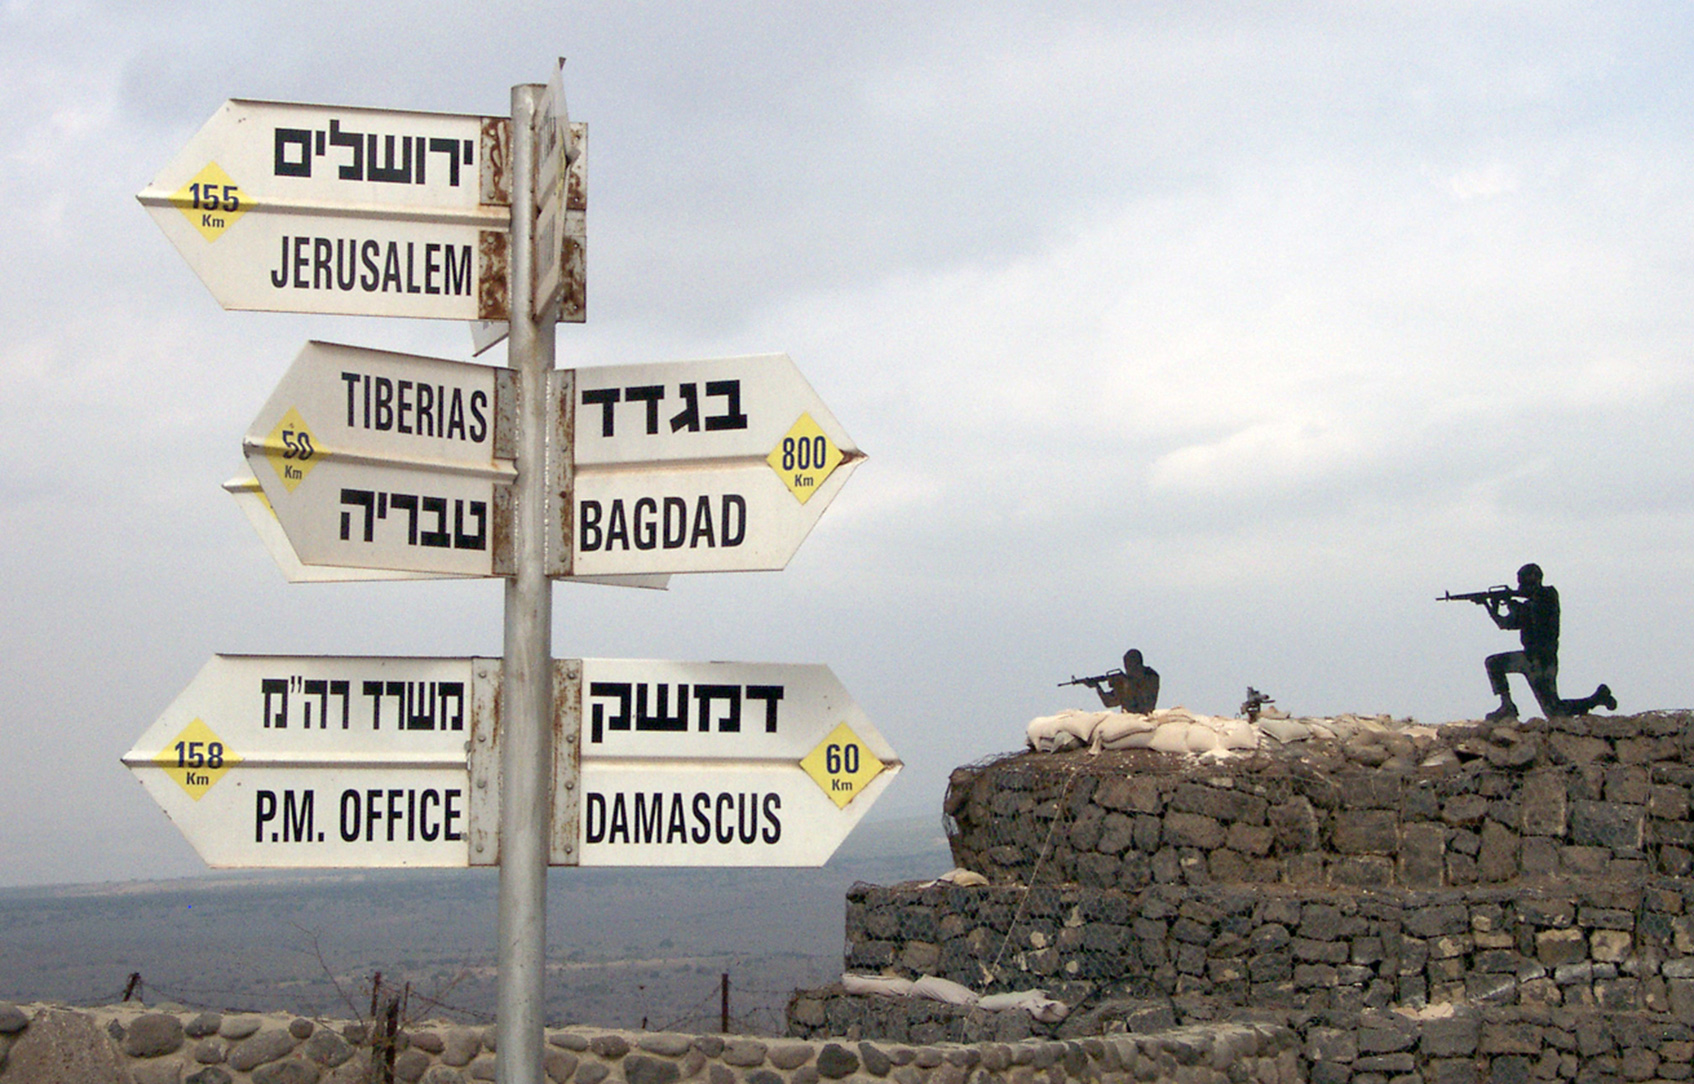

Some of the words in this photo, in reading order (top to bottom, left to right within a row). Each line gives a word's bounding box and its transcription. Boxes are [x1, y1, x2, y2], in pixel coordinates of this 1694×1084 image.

[274, 119, 474, 187] ירושלים
[188, 183, 239, 213] 155
[201, 213, 225, 228] Km
[270, 235, 473, 297] JERUSALEM
[341, 371, 488, 443] TIBERIAS
[581, 379, 748, 438] בגדד
[282, 430, 315, 461] 50
[782, 435, 827, 471] 800
[284, 465, 303, 480] Km
[794, 473, 814, 488] Km
[340, 488, 487, 551] טבריה
[580, 494, 747, 552] BAGDAD
[362, 681, 464, 731] משרד
[590, 682, 785, 744] דמשק
[174, 741, 224, 769] 158
[826, 743, 860, 775] 60
[186, 771, 209, 786] Km
[831, 778, 853, 792] Km
[255, 789, 325, 843] P.M.
[339, 788, 463, 843] OFFICE
[585, 792, 782, 845] DAMASCUS
